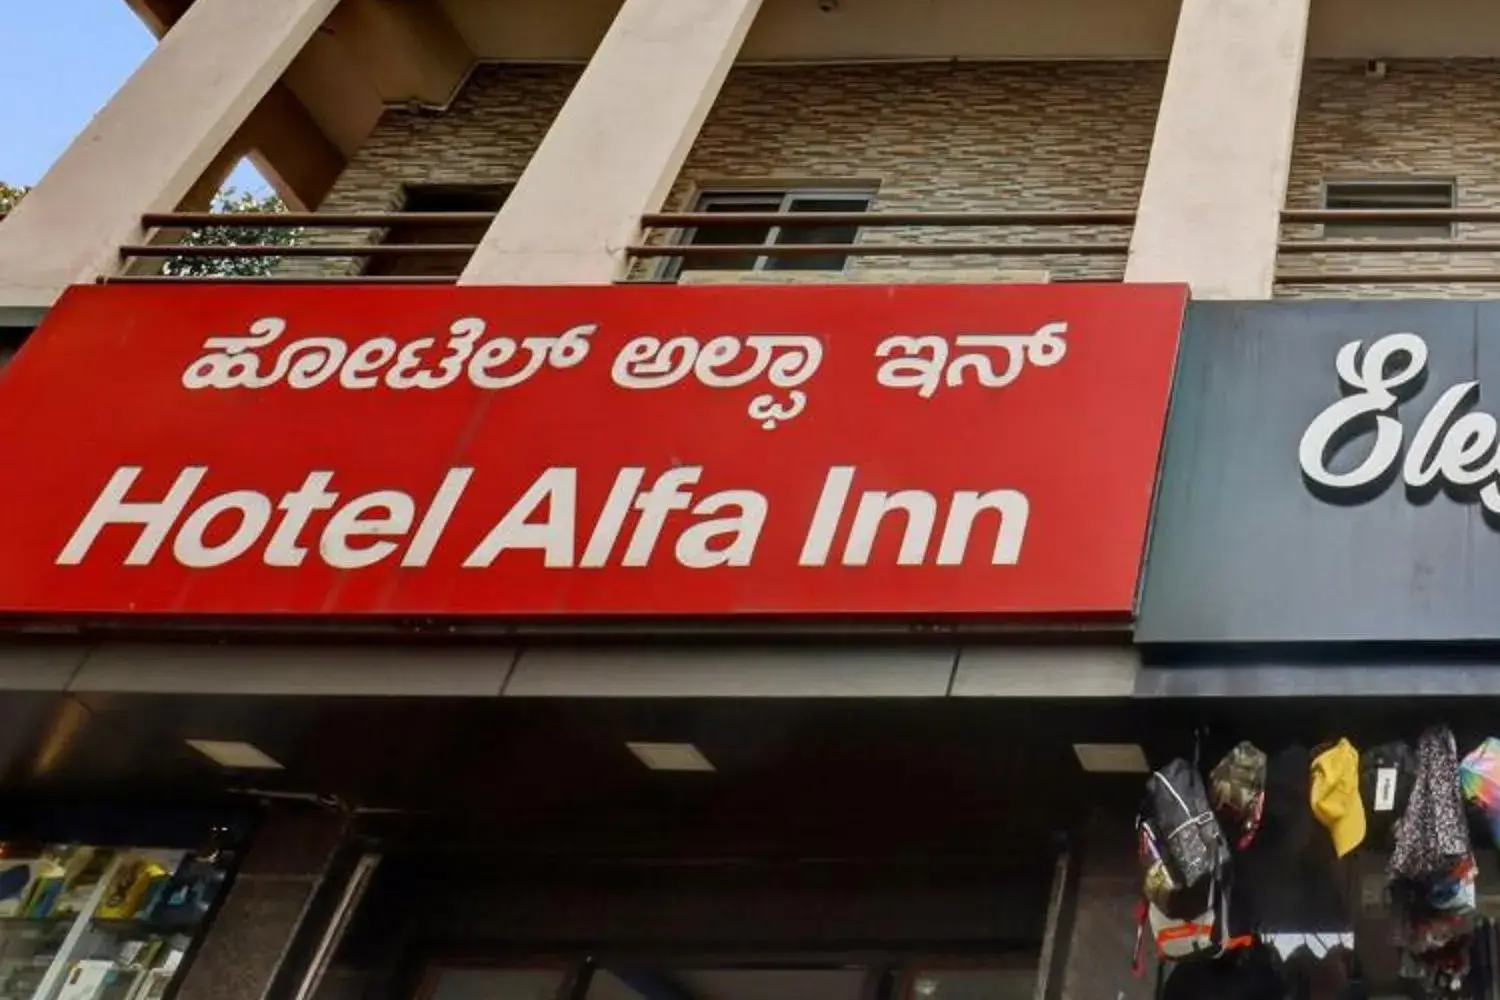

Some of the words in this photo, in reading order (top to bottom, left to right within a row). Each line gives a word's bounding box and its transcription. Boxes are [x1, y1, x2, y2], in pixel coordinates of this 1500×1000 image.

[183, 317, 596, 389] ಹೋಟೆಲ್
[612, 335, 824, 429] ಅಲ್ಫಾ
[876, 322, 1067, 397] ಇನ್
[55, 467, 473, 568] Hotel
[461, 466, 767, 568] Alfa
[799, 466, 1030, 567] Inn
